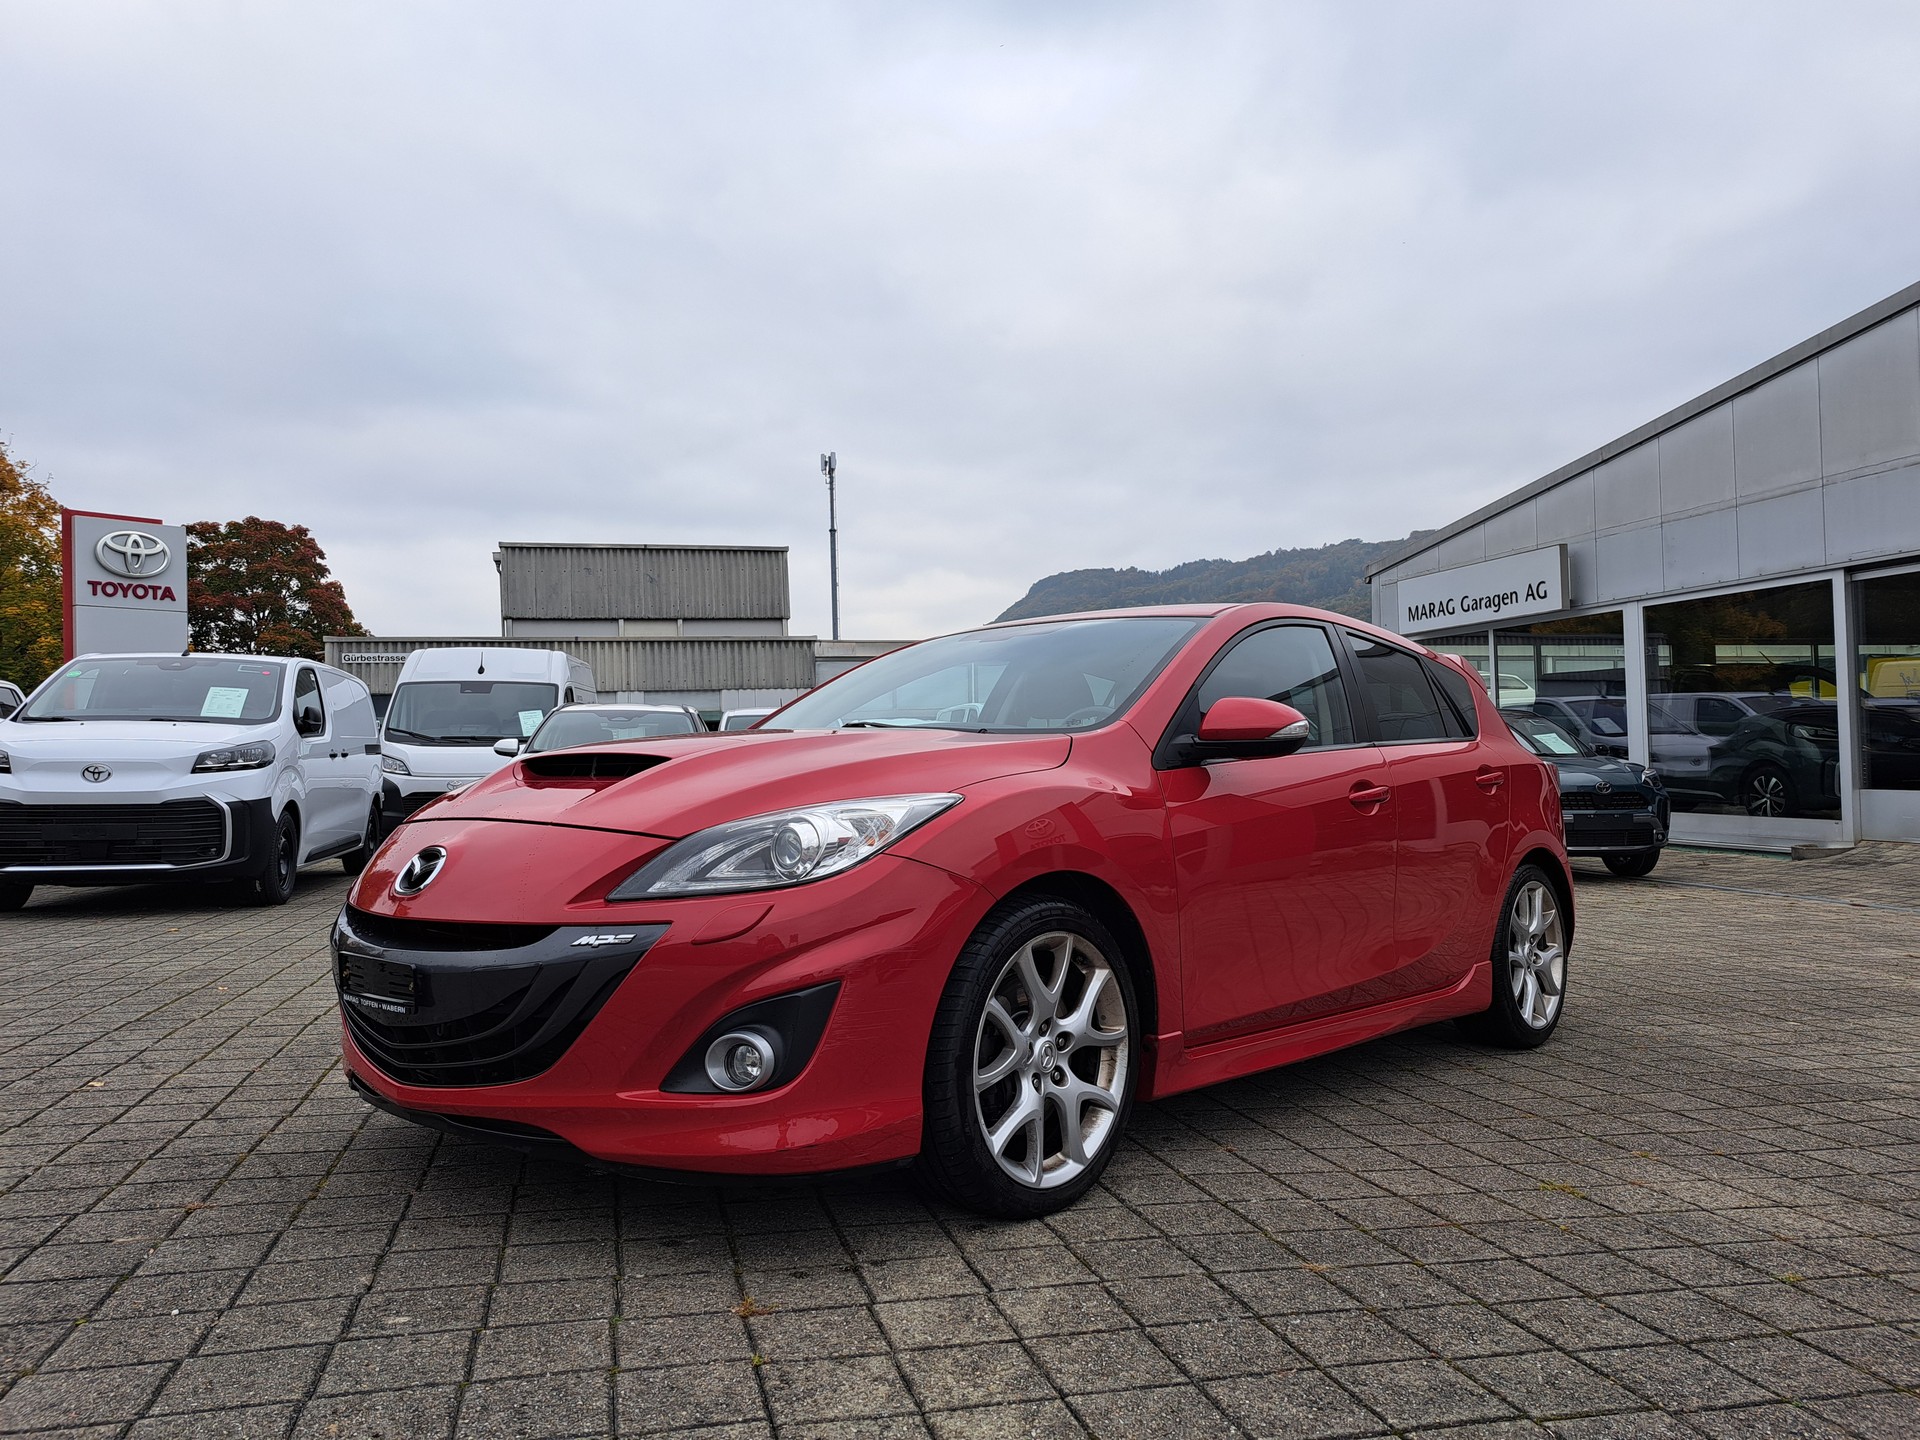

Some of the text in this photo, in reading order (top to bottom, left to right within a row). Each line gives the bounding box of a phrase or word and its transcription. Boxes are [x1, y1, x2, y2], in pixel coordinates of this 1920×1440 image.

[87, 580, 176, 601] TOYOTA
[1408, 580, 1548, 622] MARAG Garagen AG
[343, 654, 406, 662] Gürbestrasse
[343, 993, 406, 1014] MARAG TOFFEN WABERN
